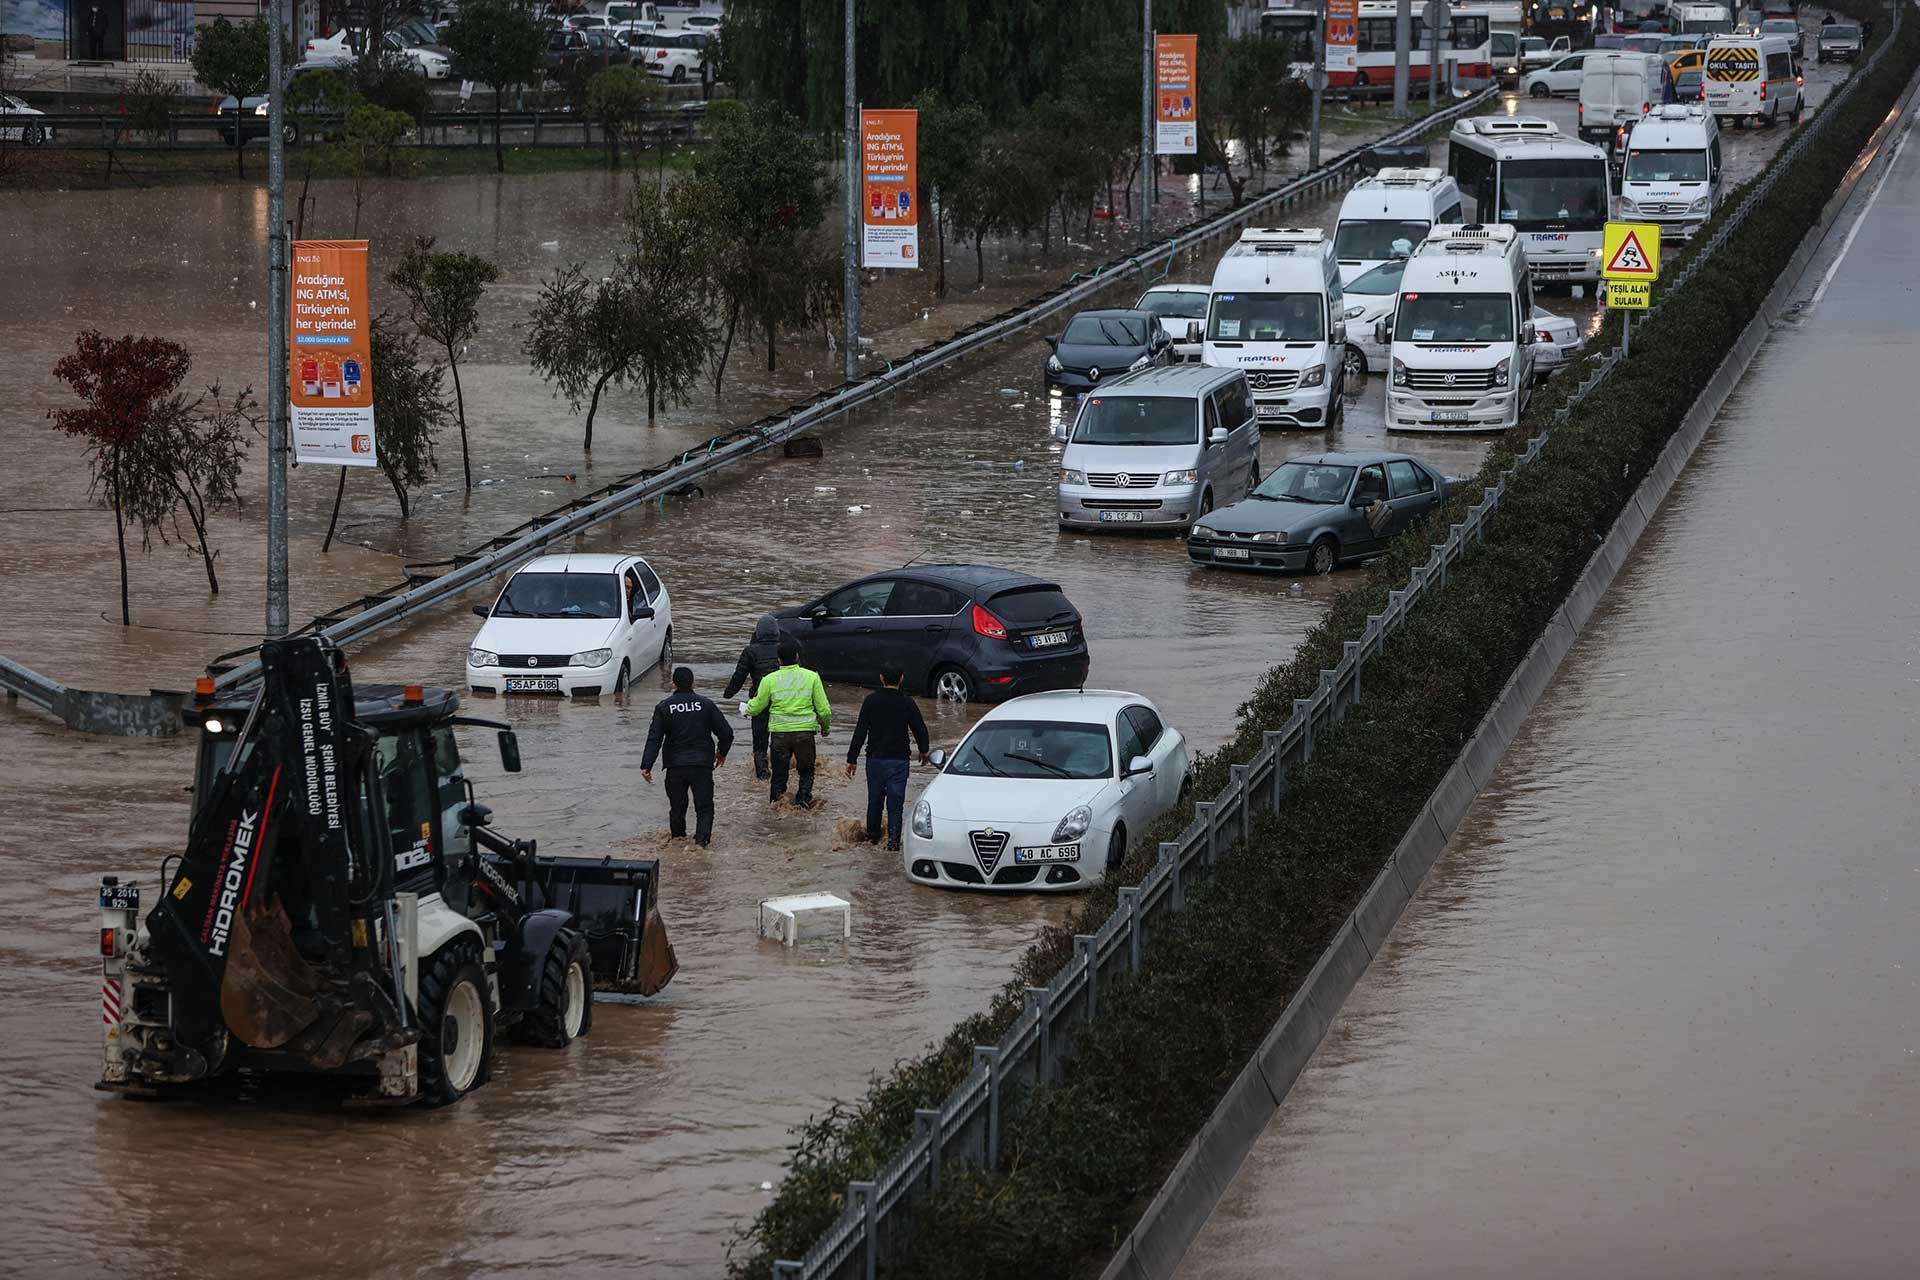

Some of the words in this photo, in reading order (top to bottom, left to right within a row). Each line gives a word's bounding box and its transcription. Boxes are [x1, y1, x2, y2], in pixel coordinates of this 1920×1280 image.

[867, 133, 900, 142] Aradığınız
[880, 143, 904, 152] ATM'si,
[867, 153, 904, 162] Türkiye'nin
[867, 163, 879, 171] her
[880, 163, 908, 173] yerinde!
[296, 274, 345, 288] Aradığınız
[1610, 283, 1628, 294] YEŞİL
[1630, 285, 1648, 294] ALAN
[296, 290, 314, 300] ING
[316, 290, 350, 302] ATM'si,
[1614, 296, 1642, 306] SULAMA
[296, 304, 350, 318] Türkiye'nin
[296, 318, 312, 328] her
[315, 320, 356, 332] yerinde!
[1104, 512, 1113, 520] 35
[512, 680, 522, 688] 35
[524, 680, 536, 688] AP
[538, 680, 556, 688] 6186
[316, 683, 331, 710] İZMİR
[300, 698, 314, 720] İZSU
[320, 712, 332, 730] BÜY
[302, 722, 314, 754] GENEL
[320, 744, 336, 772] ŞEHİR
[304, 756, 322, 816] MÜDÜRLÜĞÜ
[324, 774, 342, 829] BELEDİYESİ
[1022, 849, 1033, 860] 48
[1040, 848, 1052, 858] AC
[1058, 846, 1076, 858] 696
[102, 888, 112, 896] 35
[117, 888, 138, 898] 2014
